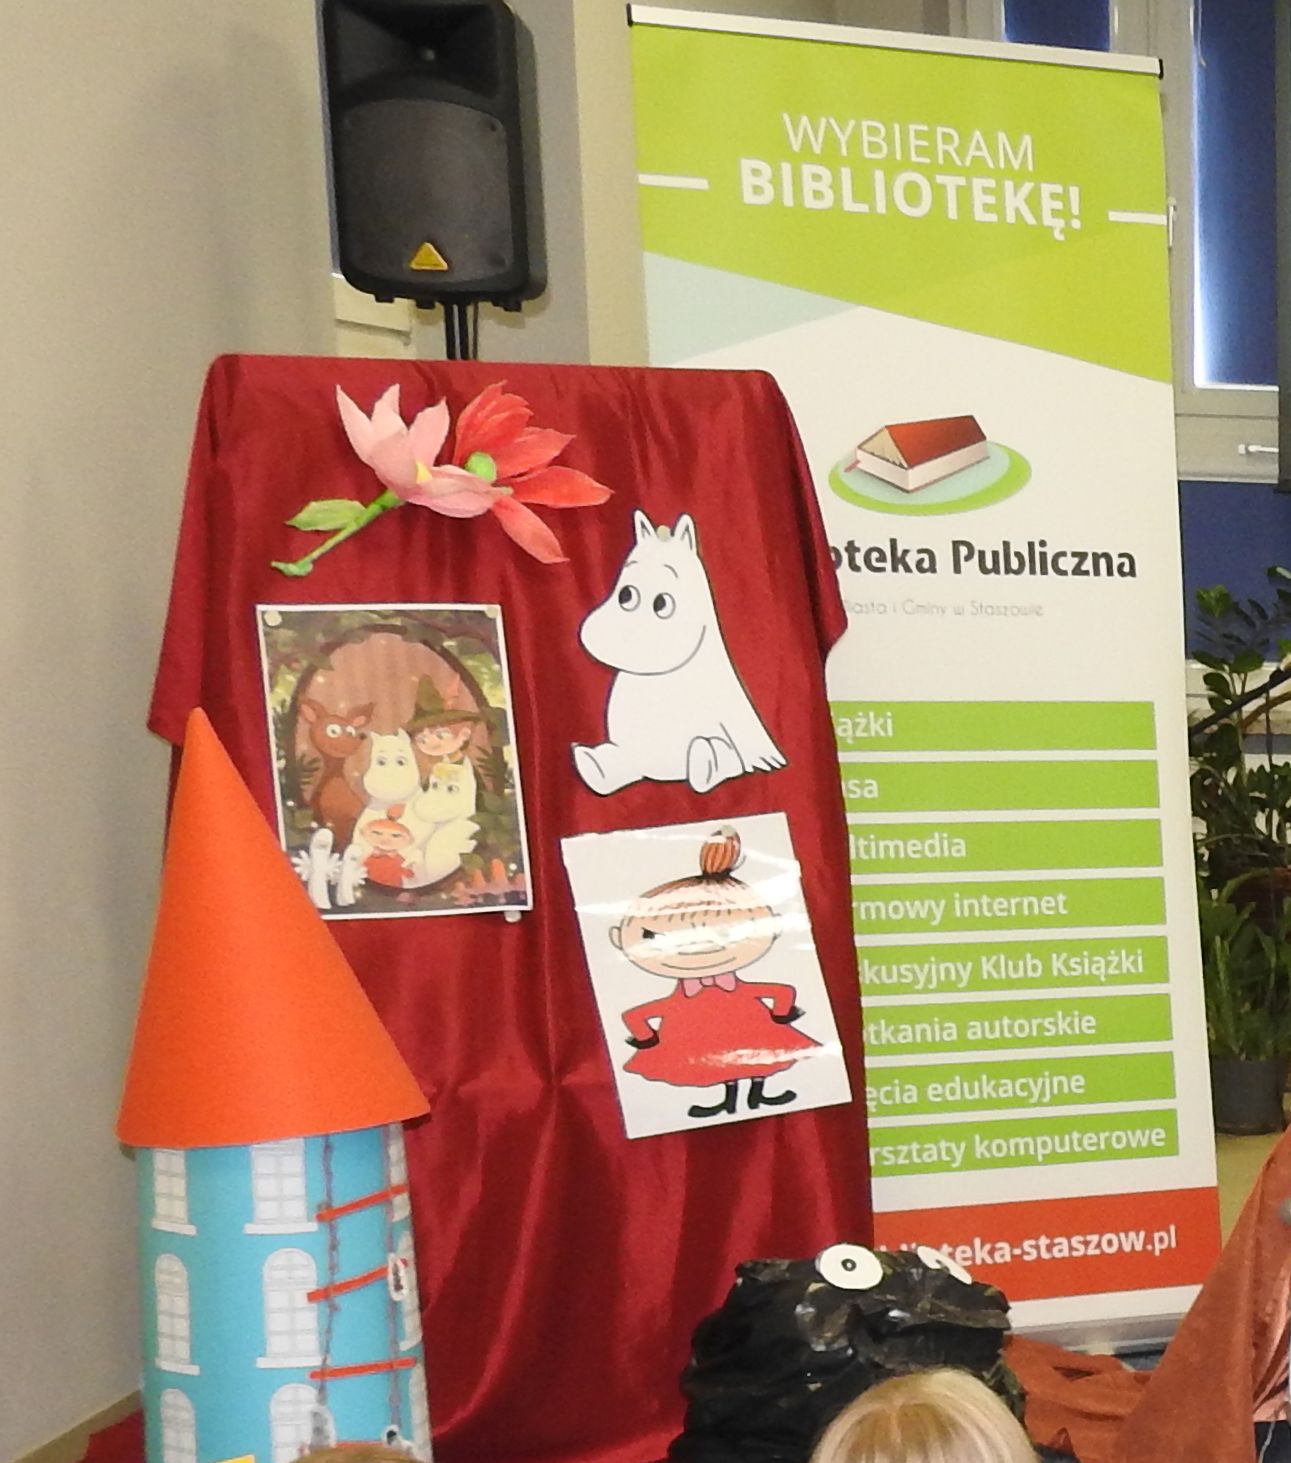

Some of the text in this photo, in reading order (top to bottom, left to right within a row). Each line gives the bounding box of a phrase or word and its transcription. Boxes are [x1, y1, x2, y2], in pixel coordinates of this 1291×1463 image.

[782, 112, 1034, 172] WYBIERAM
[740, 158, 1082, 241] BIBLIOTEKĘ!
[951, 539, 1137, 578] Publiczna
[836, 711, 893, 744] ążki
[842, 778, 879, 799] sa
[954, 892, 1069, 918] internet
[859, 948, 1145, 989] kusyjny Klub Książki
[864, 1010, 1097, 1046] tkania autorskie
[865, 1072, 1087, 1113] ęcia edukacyjne
[869, 1126, 1167, 1168] rsztaty komputerowe
